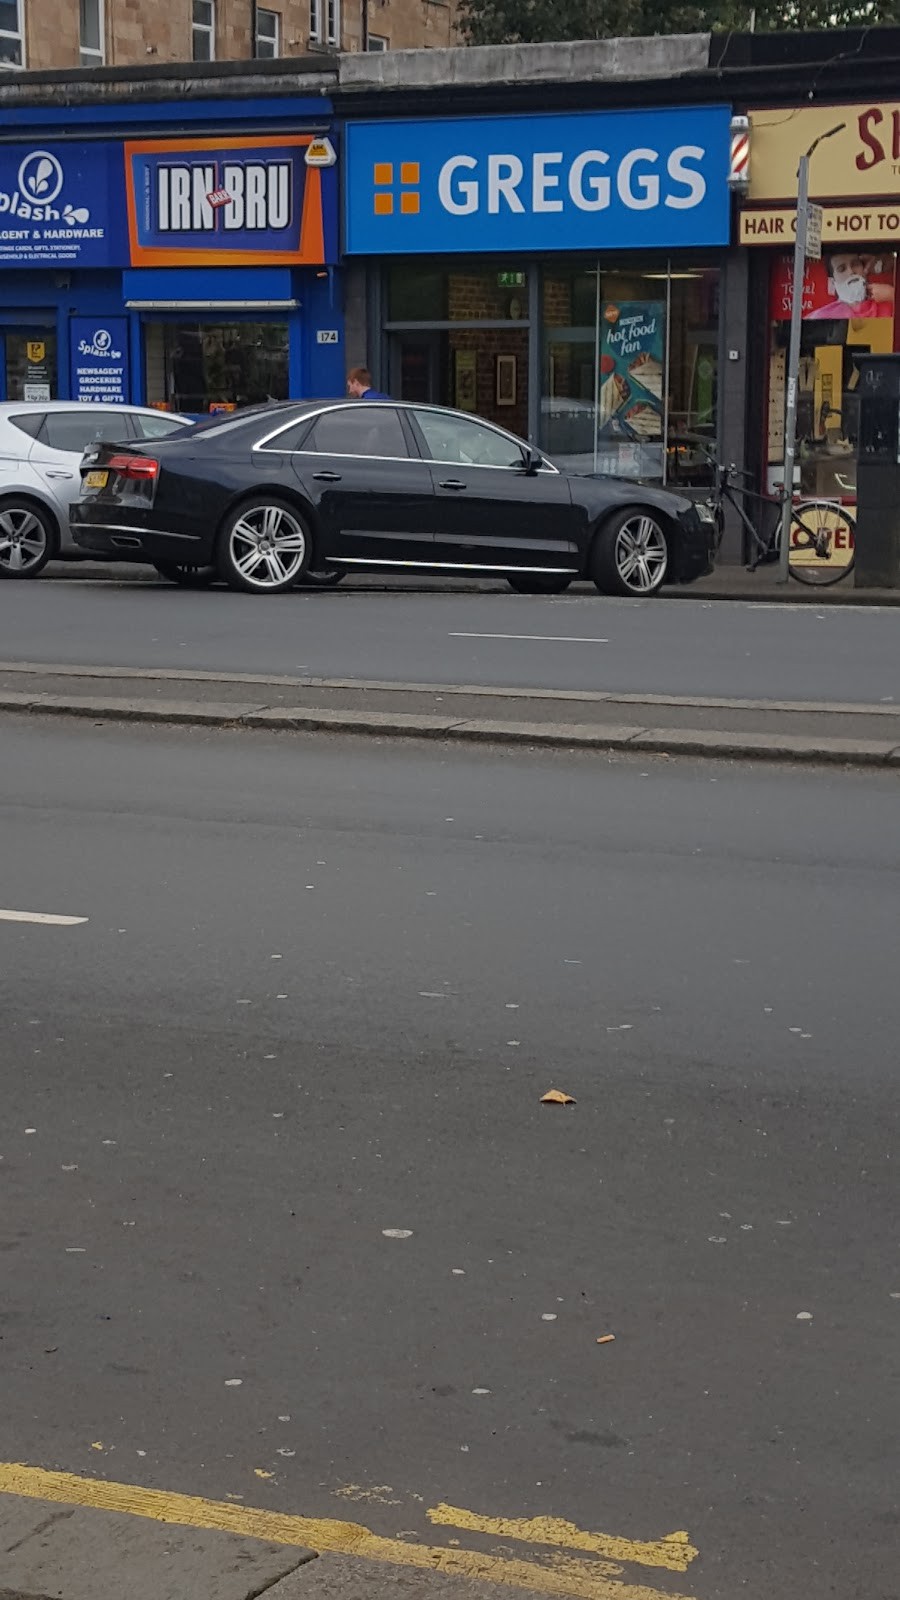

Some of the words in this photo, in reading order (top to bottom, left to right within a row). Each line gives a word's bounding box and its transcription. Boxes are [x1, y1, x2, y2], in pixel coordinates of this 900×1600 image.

[438, 145, 706, 215] GREGGS
[158, 166, 214, 230] IRN
[224, 165, 289, 229] BRU
[745, 217, 784, 234] HAIR
[836, 214, 872, 231] HOT
[877, 213, 900, 230] TO
[33, 230, 41, 239] &
[44, 228, 105, 239] HARDWARE
[321, 331, 336, 341] 174
[606, 328, 628, 344] hot
[628, 317, 656, 341] food
[620, 339, 642, 357] fan
[78, 394, 93, 402] TOY
[102, 394, 124, 402] GIFTS
